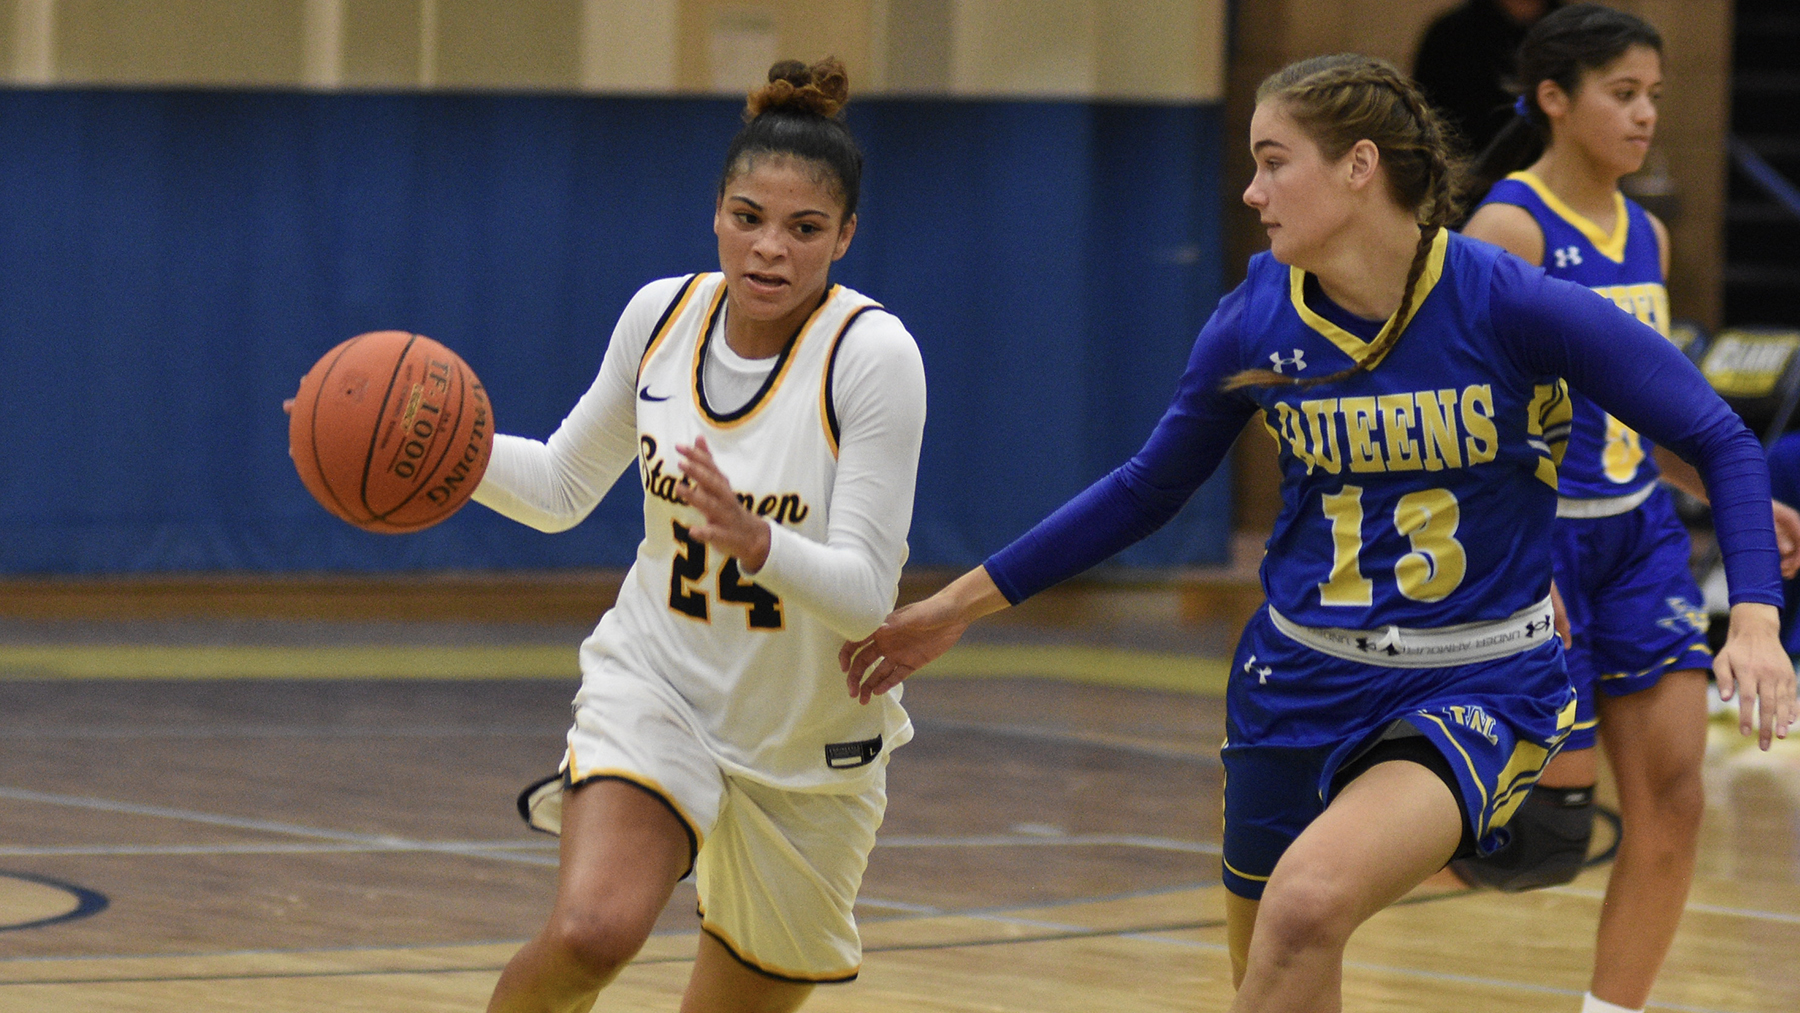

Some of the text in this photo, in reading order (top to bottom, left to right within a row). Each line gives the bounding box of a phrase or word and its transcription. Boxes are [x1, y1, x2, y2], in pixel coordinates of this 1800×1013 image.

[394, 360, 449, 479] TF-1000
[427, 380, 486, 507] PALDING
[1274, 384, 1499, 475] QUEENS
[640, 434, 809, 525] Staen
[668, 517, 785, 631] 24
[1317, 485, 1467, 607] 13
[1475, 630, 1521, 648] UNDER
